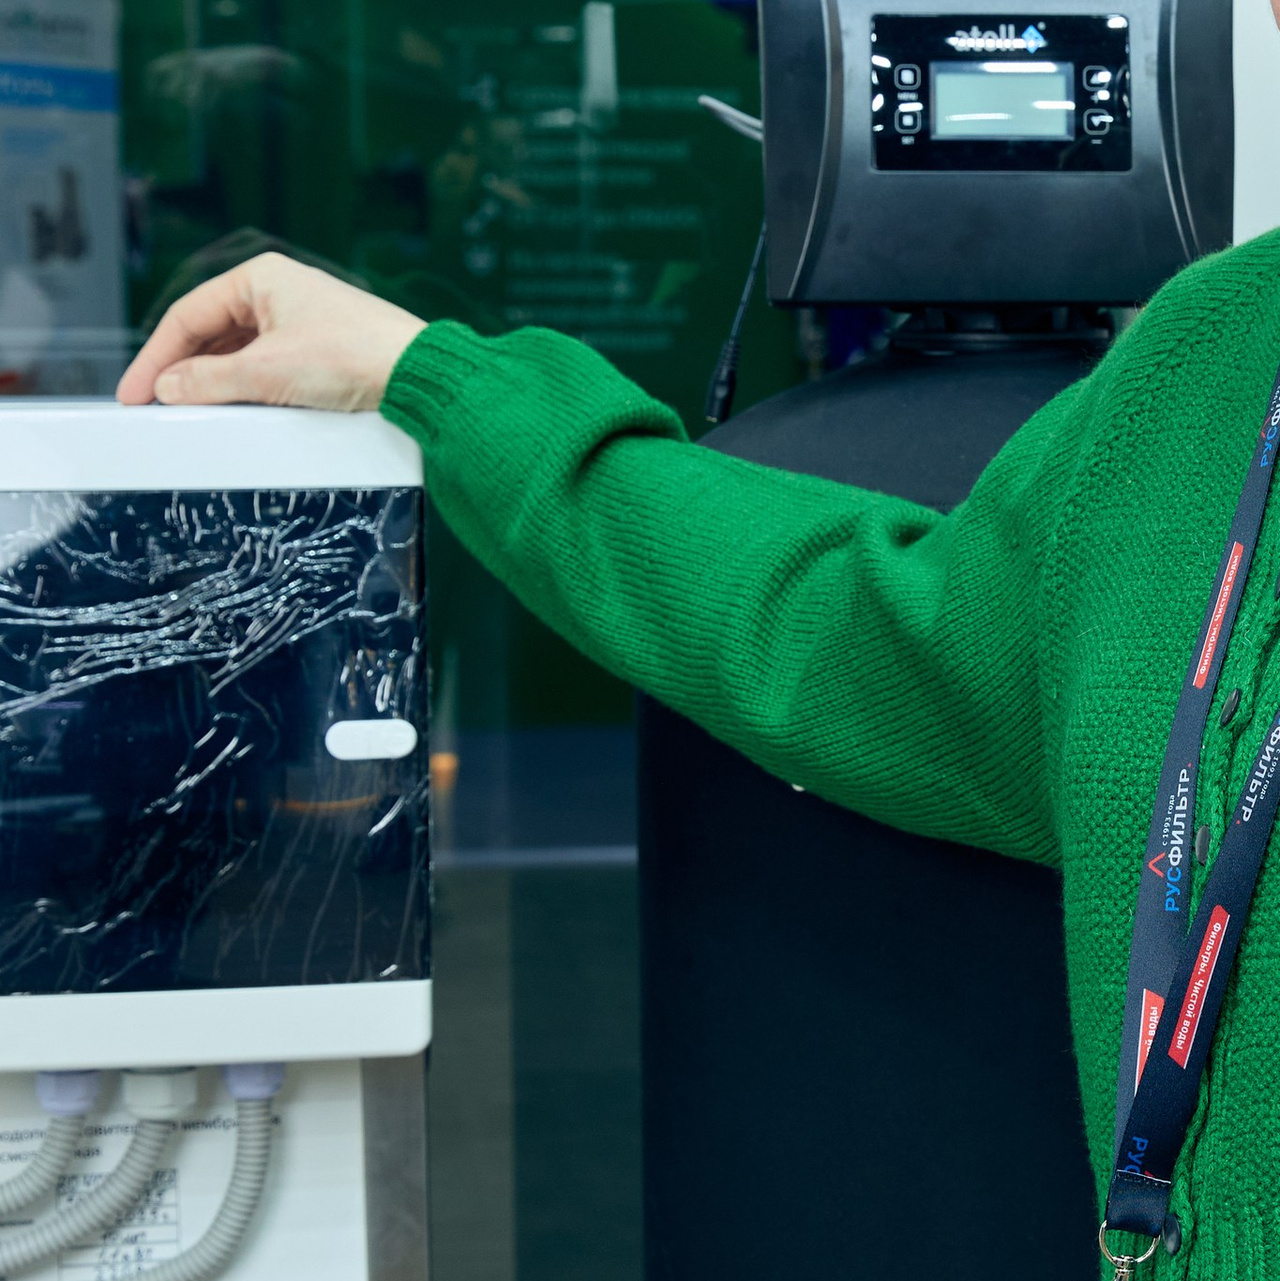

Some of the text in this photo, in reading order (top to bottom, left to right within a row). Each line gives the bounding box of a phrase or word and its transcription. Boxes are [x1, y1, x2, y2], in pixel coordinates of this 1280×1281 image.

[954, 23, 1016, 52] atoll
[1199, 555, 1239, 674] Фильтры. Чистой воды
[1267, 756, 1279, 778] 1993
[1259, 780, 1270, 800] года
[1162, 817, 1172, 839] 1993
[1167, 794, 1175, 815] года
[1176, 922, 1222, 1050] Фильтры. Чистой воды
[1148, 1006, 1158, 1036] воды
